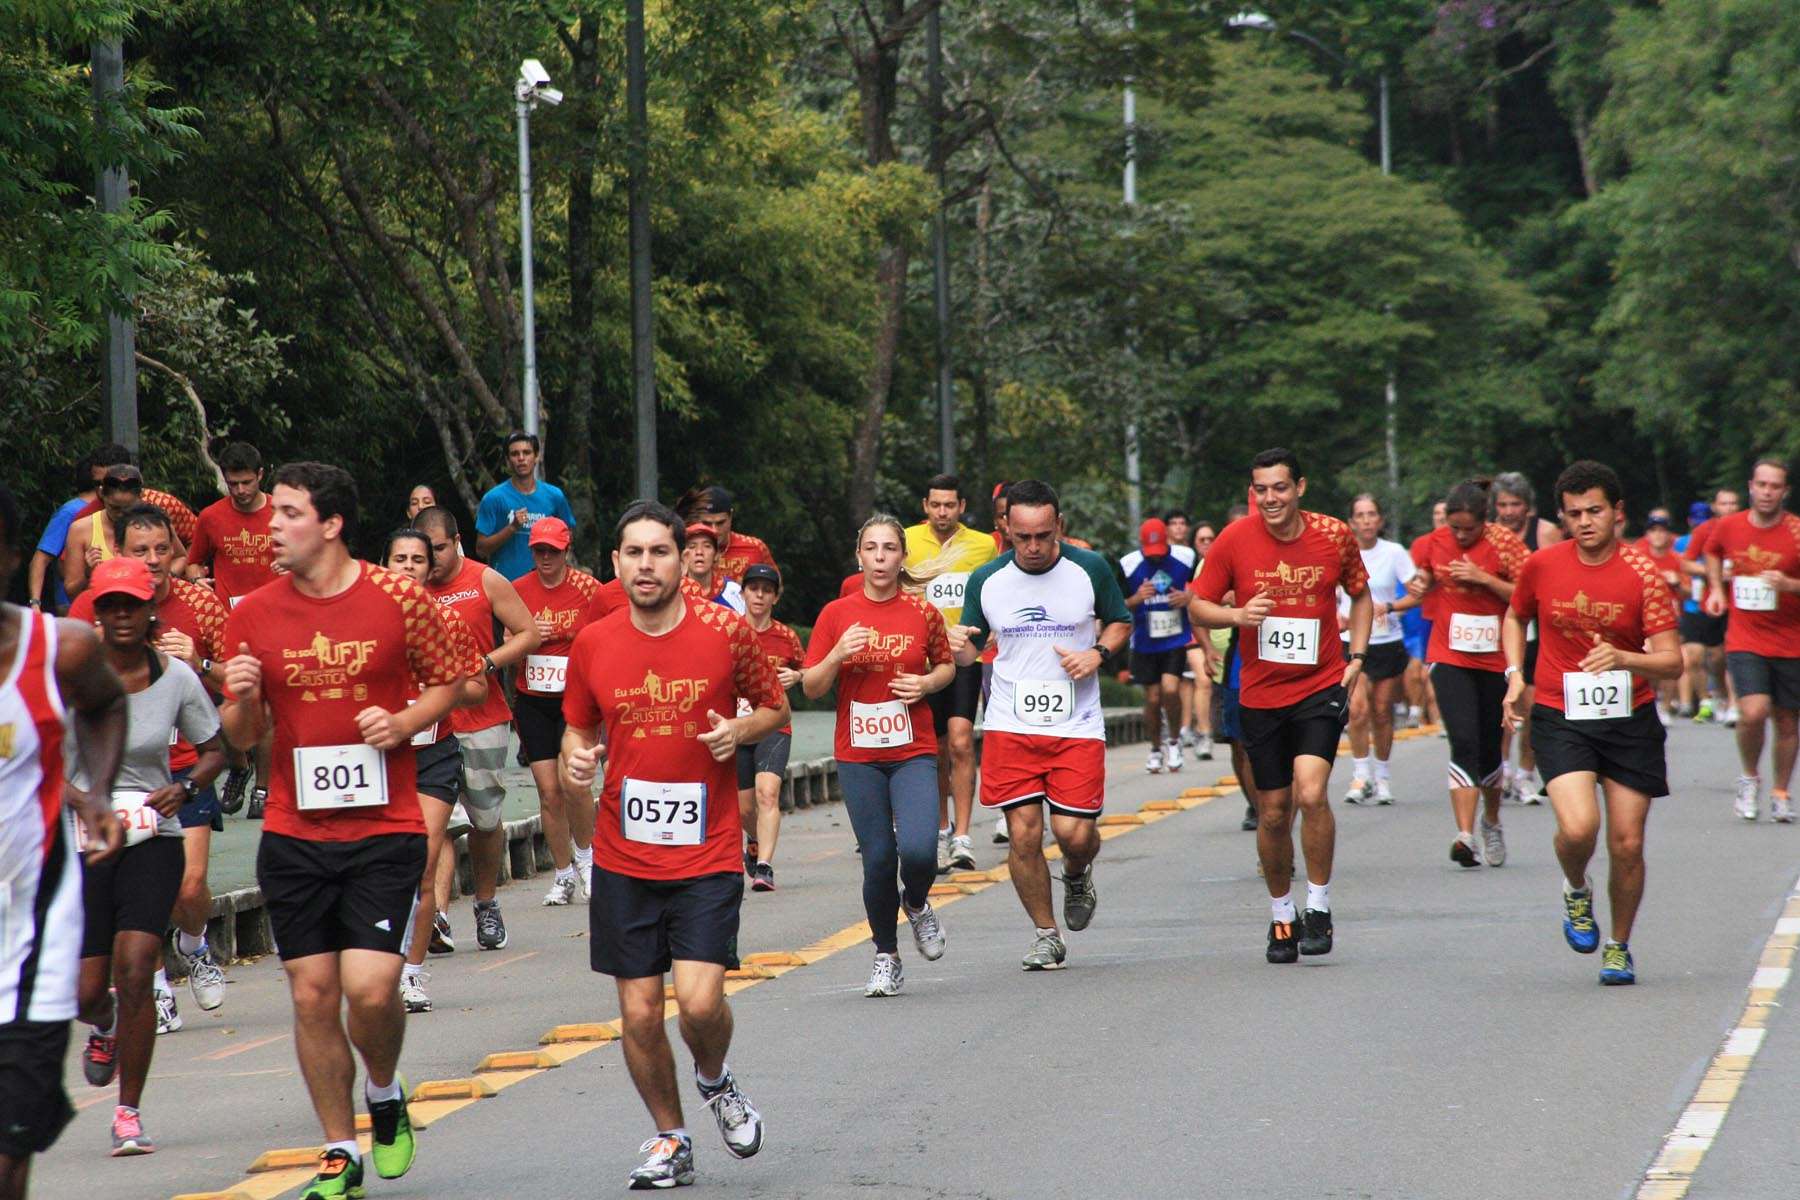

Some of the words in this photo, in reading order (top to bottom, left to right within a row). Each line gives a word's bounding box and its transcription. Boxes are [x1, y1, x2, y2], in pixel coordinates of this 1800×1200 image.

[1286, 566, 1325, 589] UFJF
[933, 583, 964, 599] 840
[550, 608, 579, 628] UFJF
[1268, 630, 1307, 651] 491
[1453, 625, 1495, 642] 3670
[873, 633, 914, 657] UFJF
[324, 640, 378, 676] UFJF
[528, 665, 567, 683] 3370
[614, 688, 627, 698] Eu
[629, 686, 648, 696] sou
[656, 678, 709, 713] UFJF
[1024, 694, 1064, 713] 992
[1577, 685, 1619, 706] 102
[853, 712, 907, 735] 3600
[314, 763, 369, 791] 801
[627, 797, 699, 825] 0573
